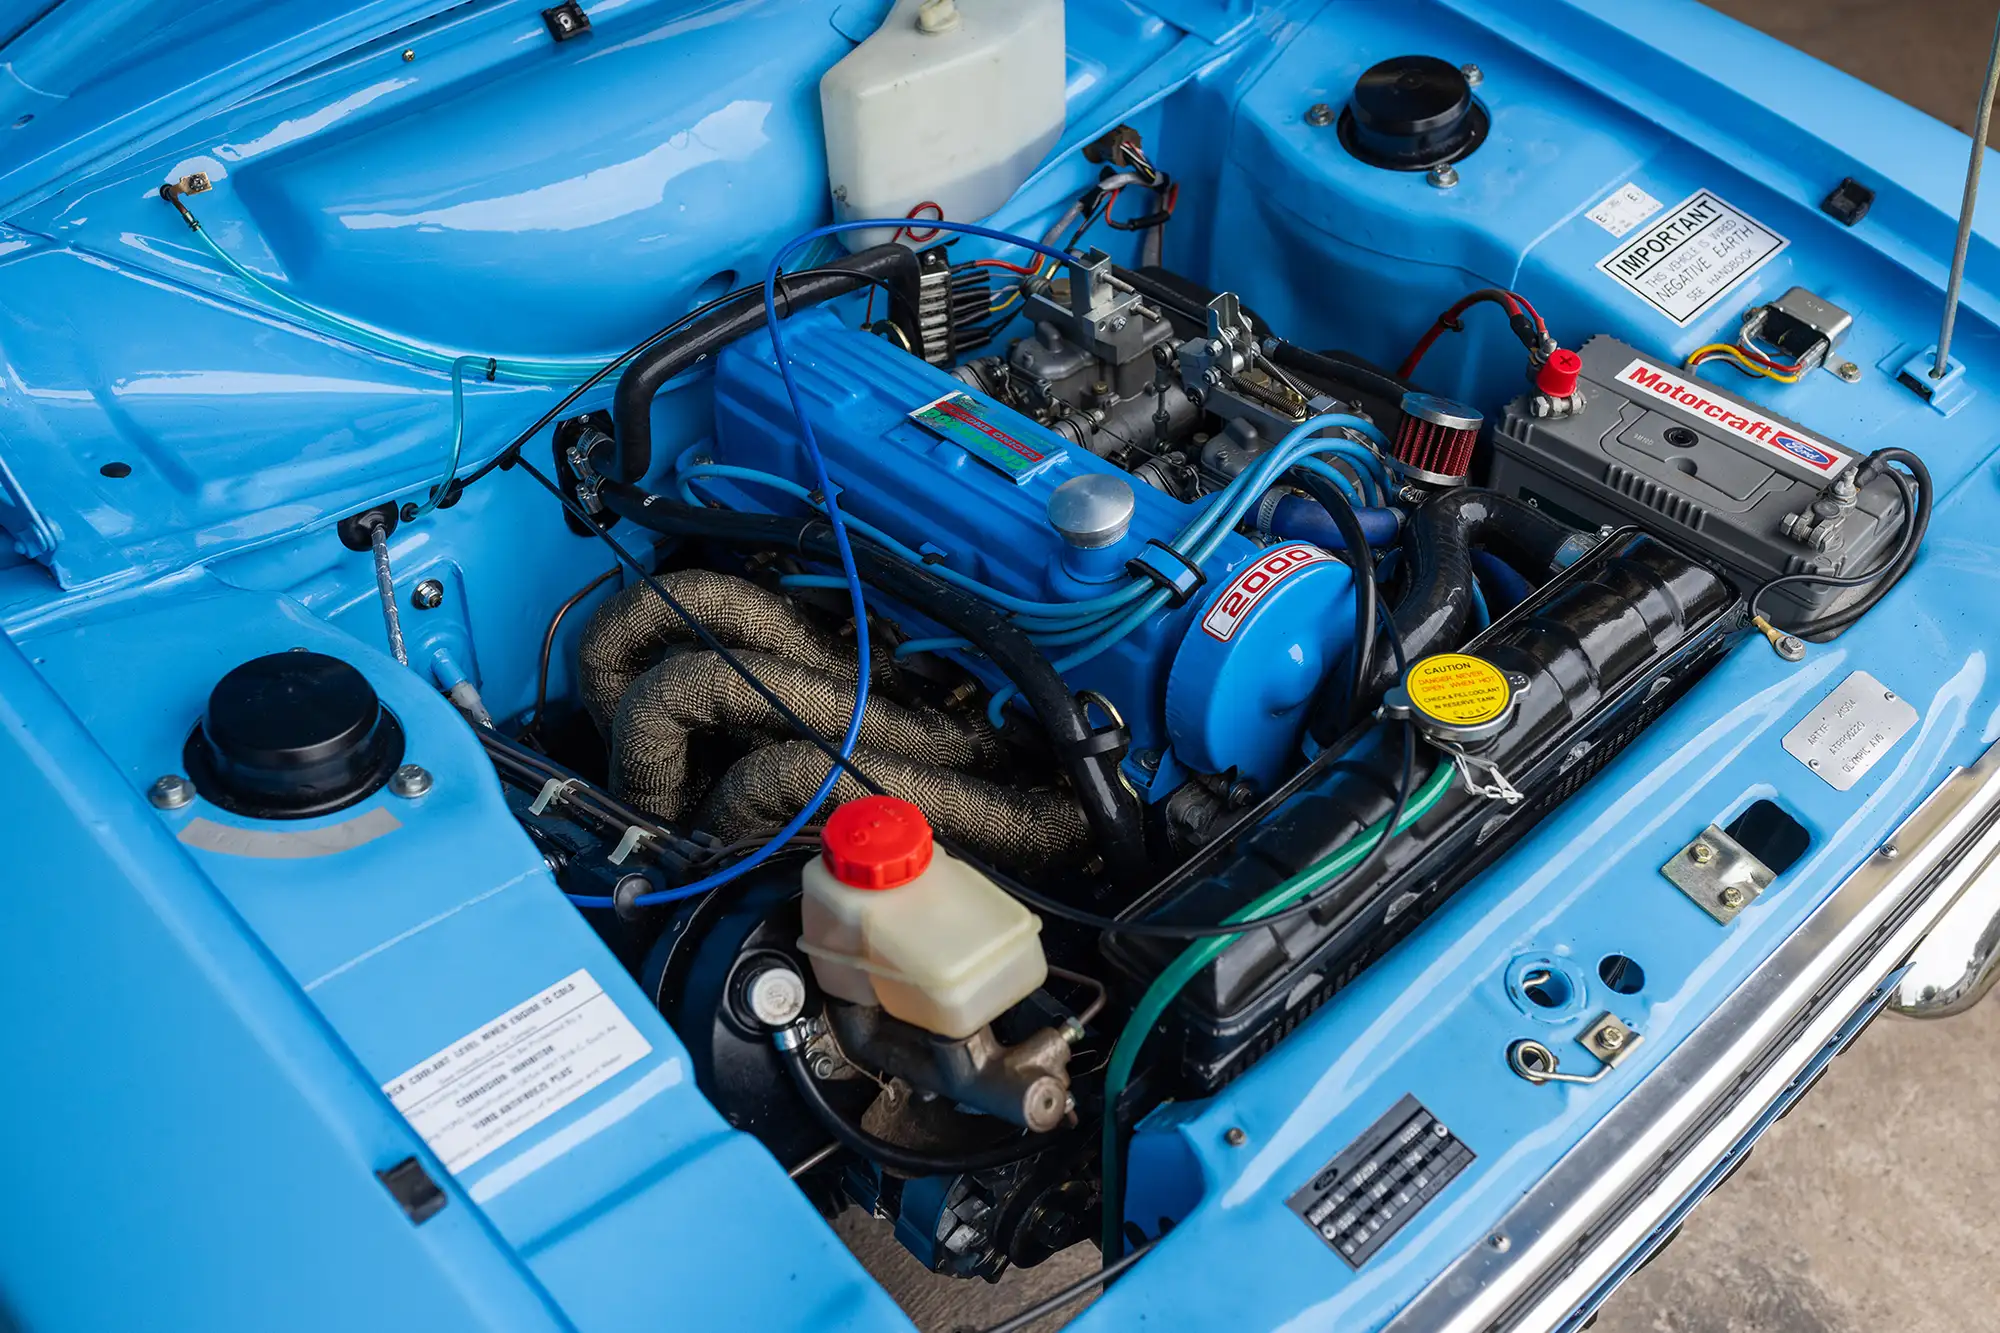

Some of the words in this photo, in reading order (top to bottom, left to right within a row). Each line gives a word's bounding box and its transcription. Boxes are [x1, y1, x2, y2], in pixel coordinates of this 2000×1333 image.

[1616, 200, 1717, 276] IMPORTANT
[1645, 269, 1669, 289] THIS
[1667, 247, 1700, 274] VEHICLE
[1698, 240, 1709, 253] IS
[1708, 220, 1737, 240] WIRED
[1656, 256, 1712, 302] NEGATIVE
[1712, 224, 1754, 258] EARTH
[1687, 286, 1705, 302] SEE
[1707, 247, 1757, 286] HANDBOOK
[1628, 366, 1773, 441] Motorcraft
[1786, 440, 1820, 461] Ford
[1222, 549, 1313, 618] 2000
[1421, 684, 1445, 693] OPEN
[1450, 679, 1475, 688] WHEN
[1479, 676, 1496, 685] HOT
[1424, 662, 1471, 675] CAUTION
[1424, 695, 1446, 703] CHECK
[1468, 686, 1500, 696] COOLANT
[1455, 670, 1484, 680] NEVER
[1443, 699, 1476, 708] RESERVE
